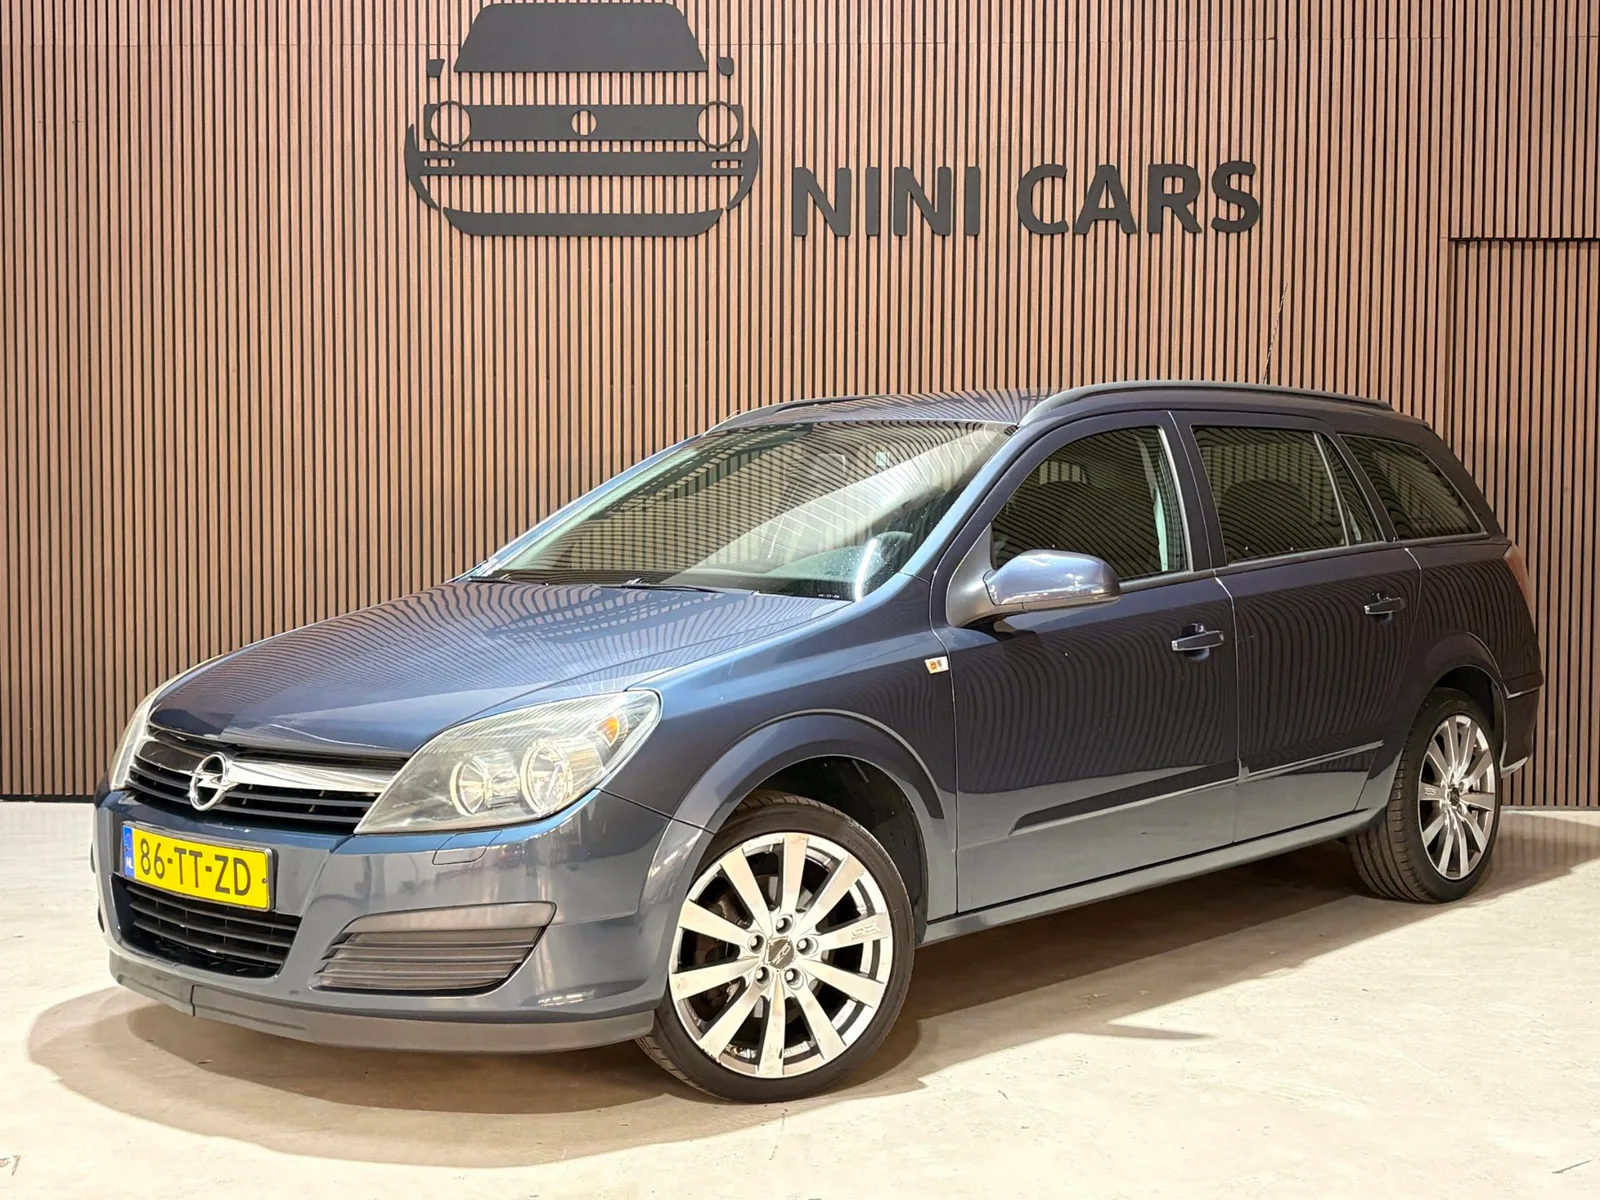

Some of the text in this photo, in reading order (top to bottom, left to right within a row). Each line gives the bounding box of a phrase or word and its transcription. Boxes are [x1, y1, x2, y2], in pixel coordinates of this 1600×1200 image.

[793, 160, 1260, 236] NINI CARS
[140, 838, 251, 896] 86-TT-ZD
